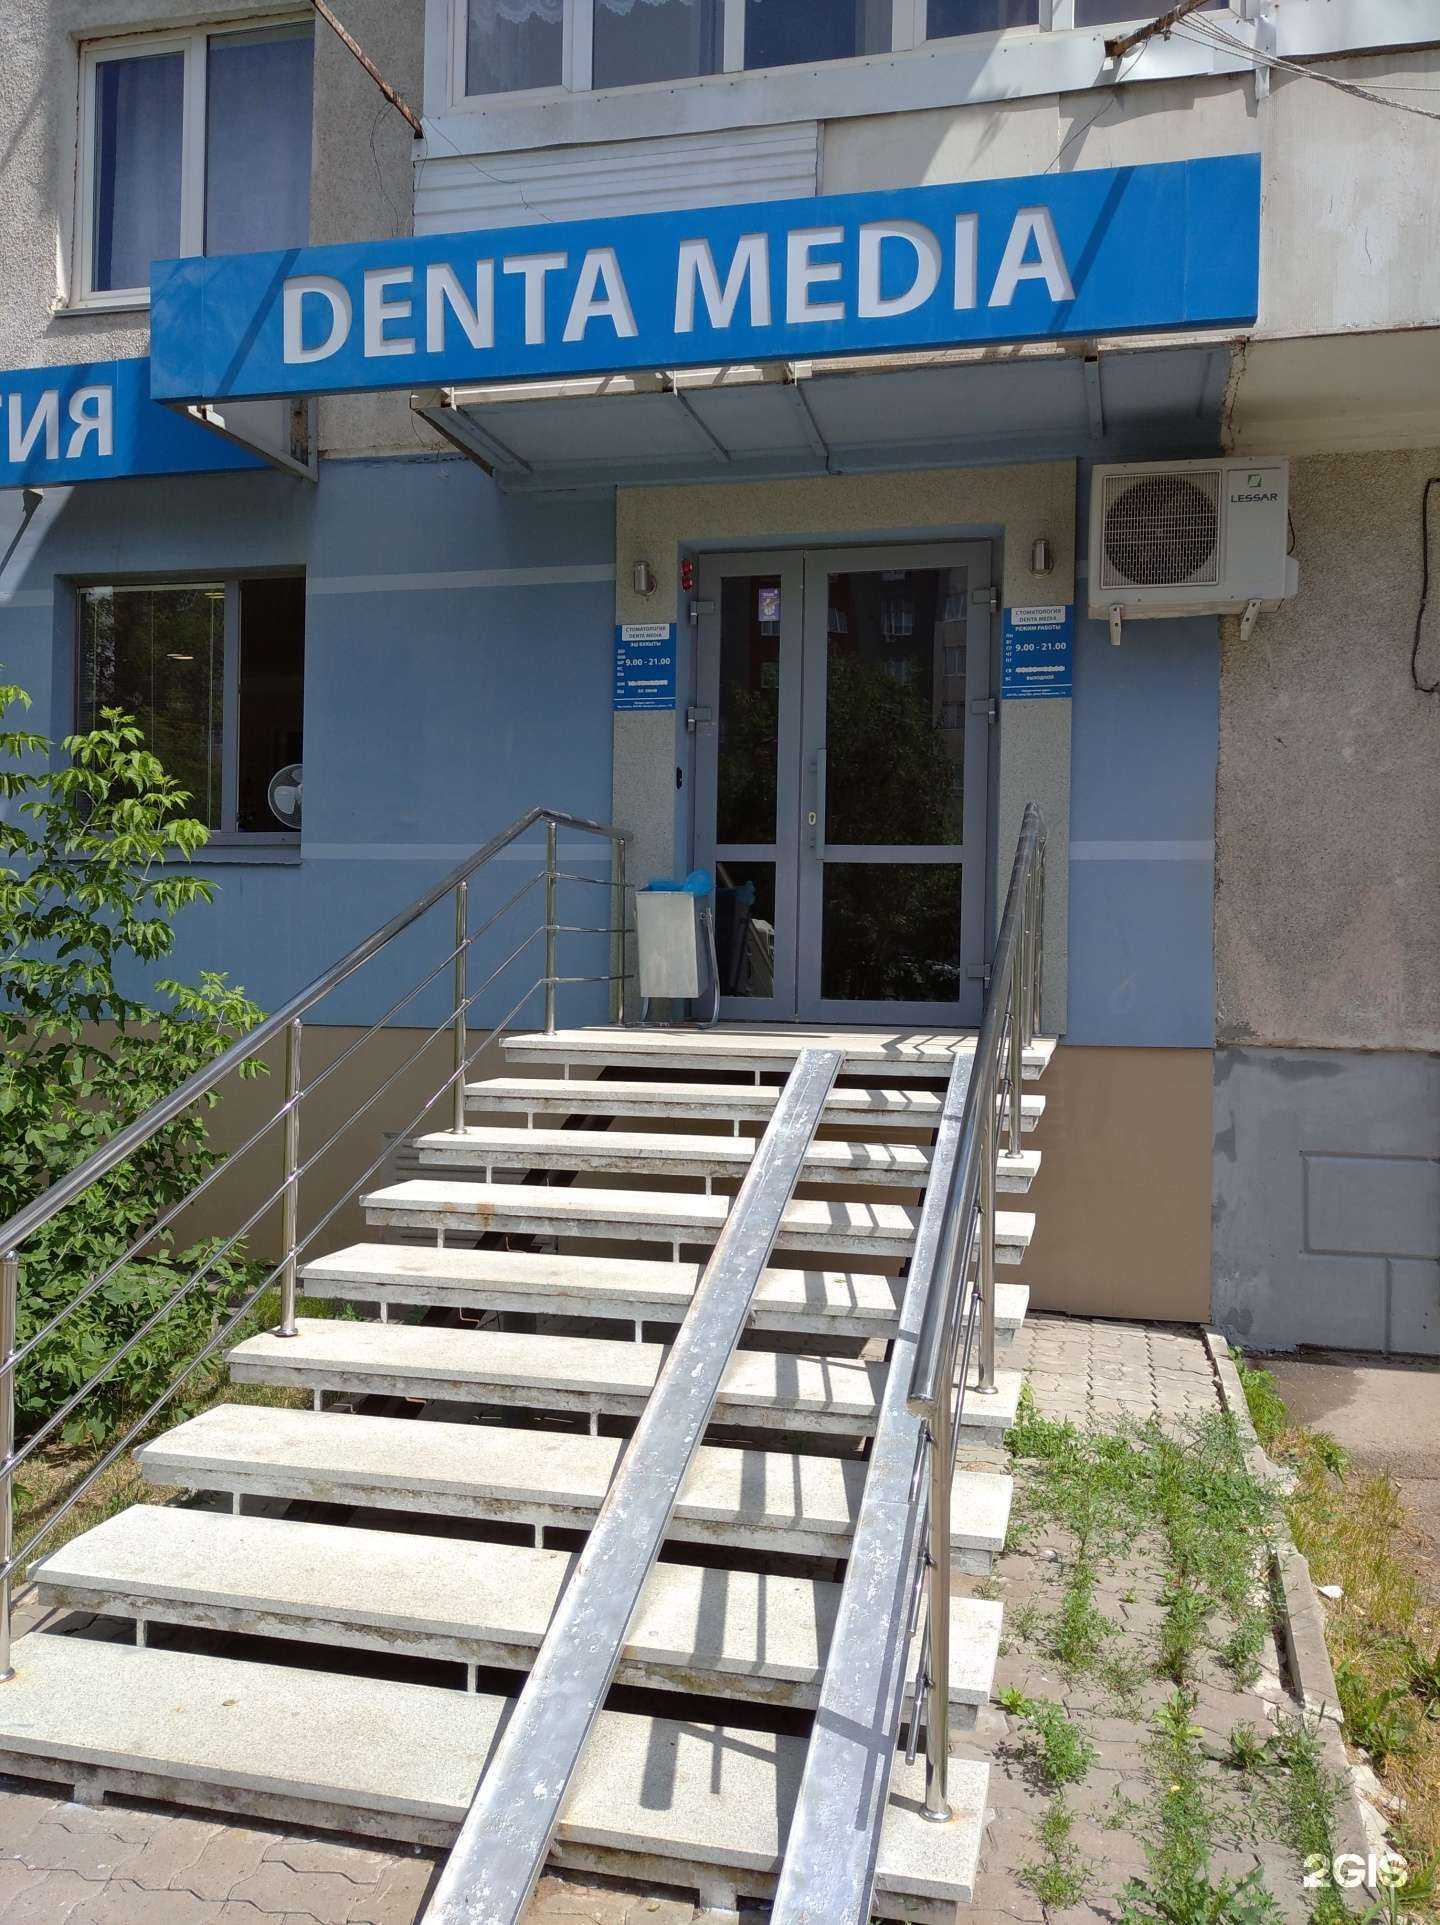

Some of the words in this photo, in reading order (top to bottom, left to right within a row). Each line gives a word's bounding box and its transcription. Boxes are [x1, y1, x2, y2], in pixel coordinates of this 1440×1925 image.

[283, 247, 639, 365] DENTA
[673, 205, 1076, 334] MEDIA
[0, 384, 113, 463] ИЯ
[1230, 492, 1278, 503] LESSAR
[1015, 643, 1035, 652] 9.00
[1040, 642, 1067, 651] 21.00
[625, 658, 643, 666] 9.00
[648, 657, 671, 666] 21.00
